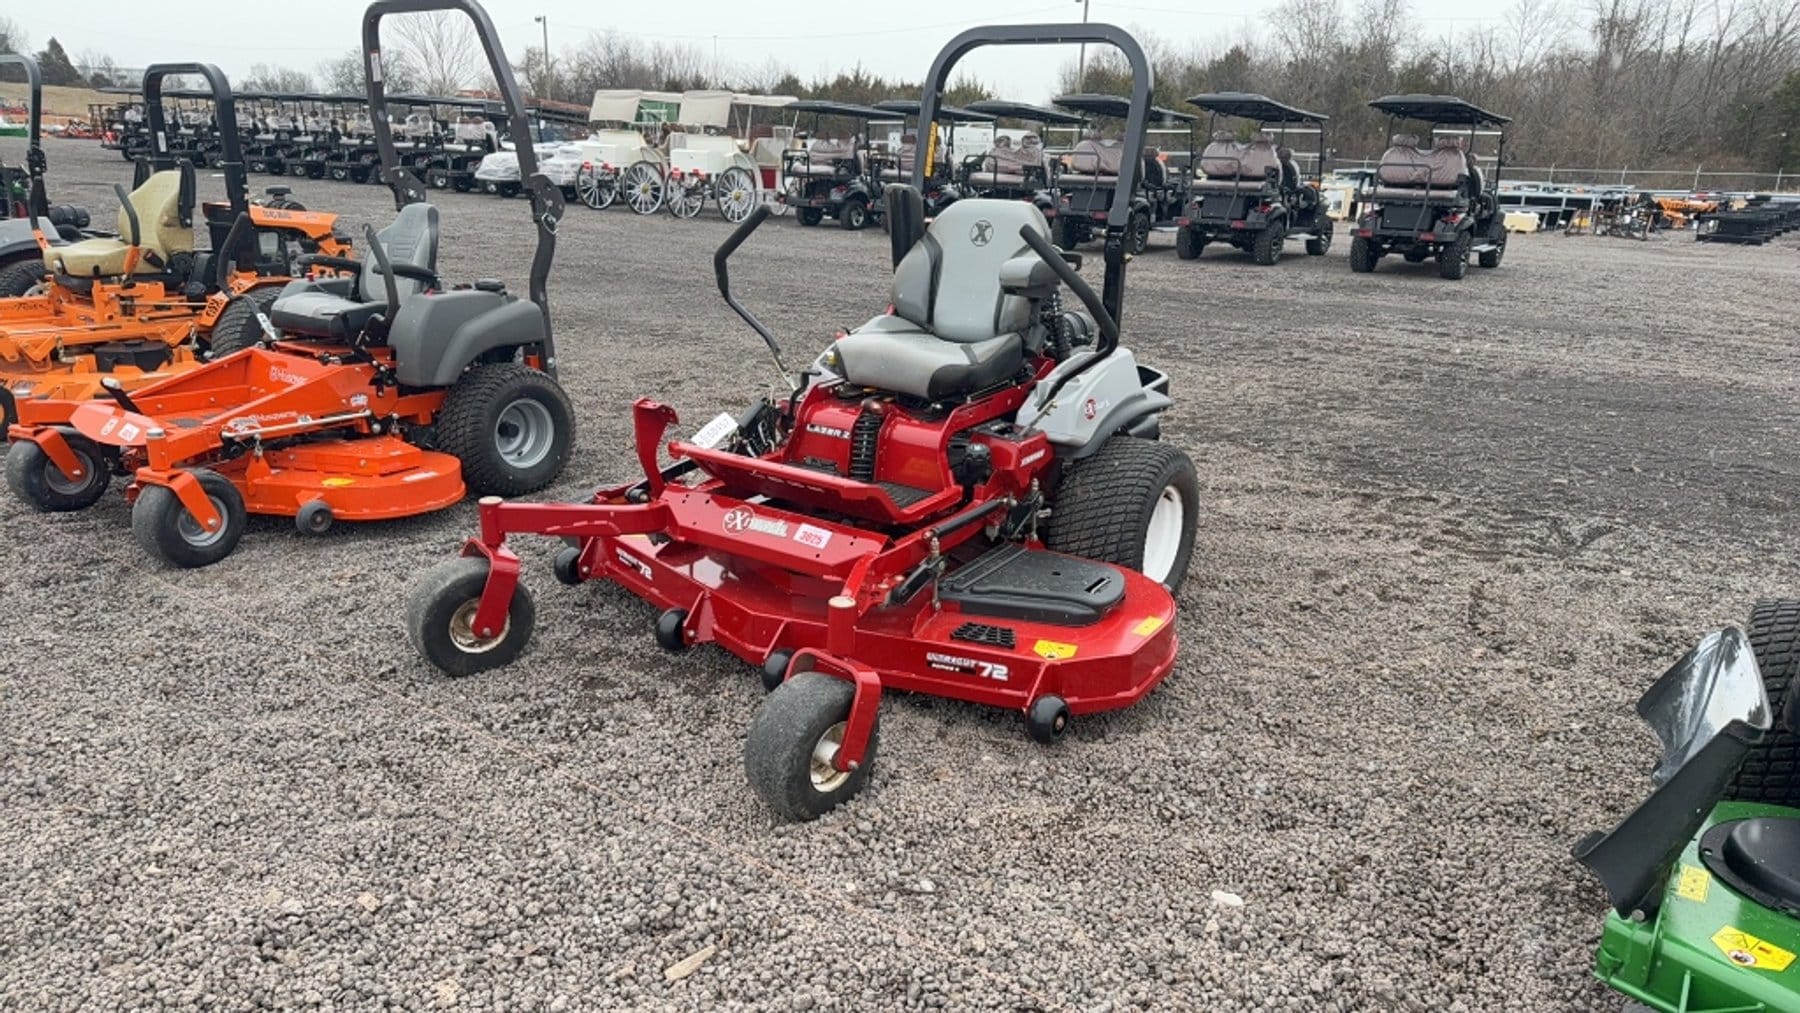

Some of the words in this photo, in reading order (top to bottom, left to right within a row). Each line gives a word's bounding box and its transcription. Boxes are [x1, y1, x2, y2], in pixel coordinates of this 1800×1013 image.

[806, 423, 842, 438] LAZER
[842, 430, 851, 439] Z
[978, 661, 1009, 681] 72
